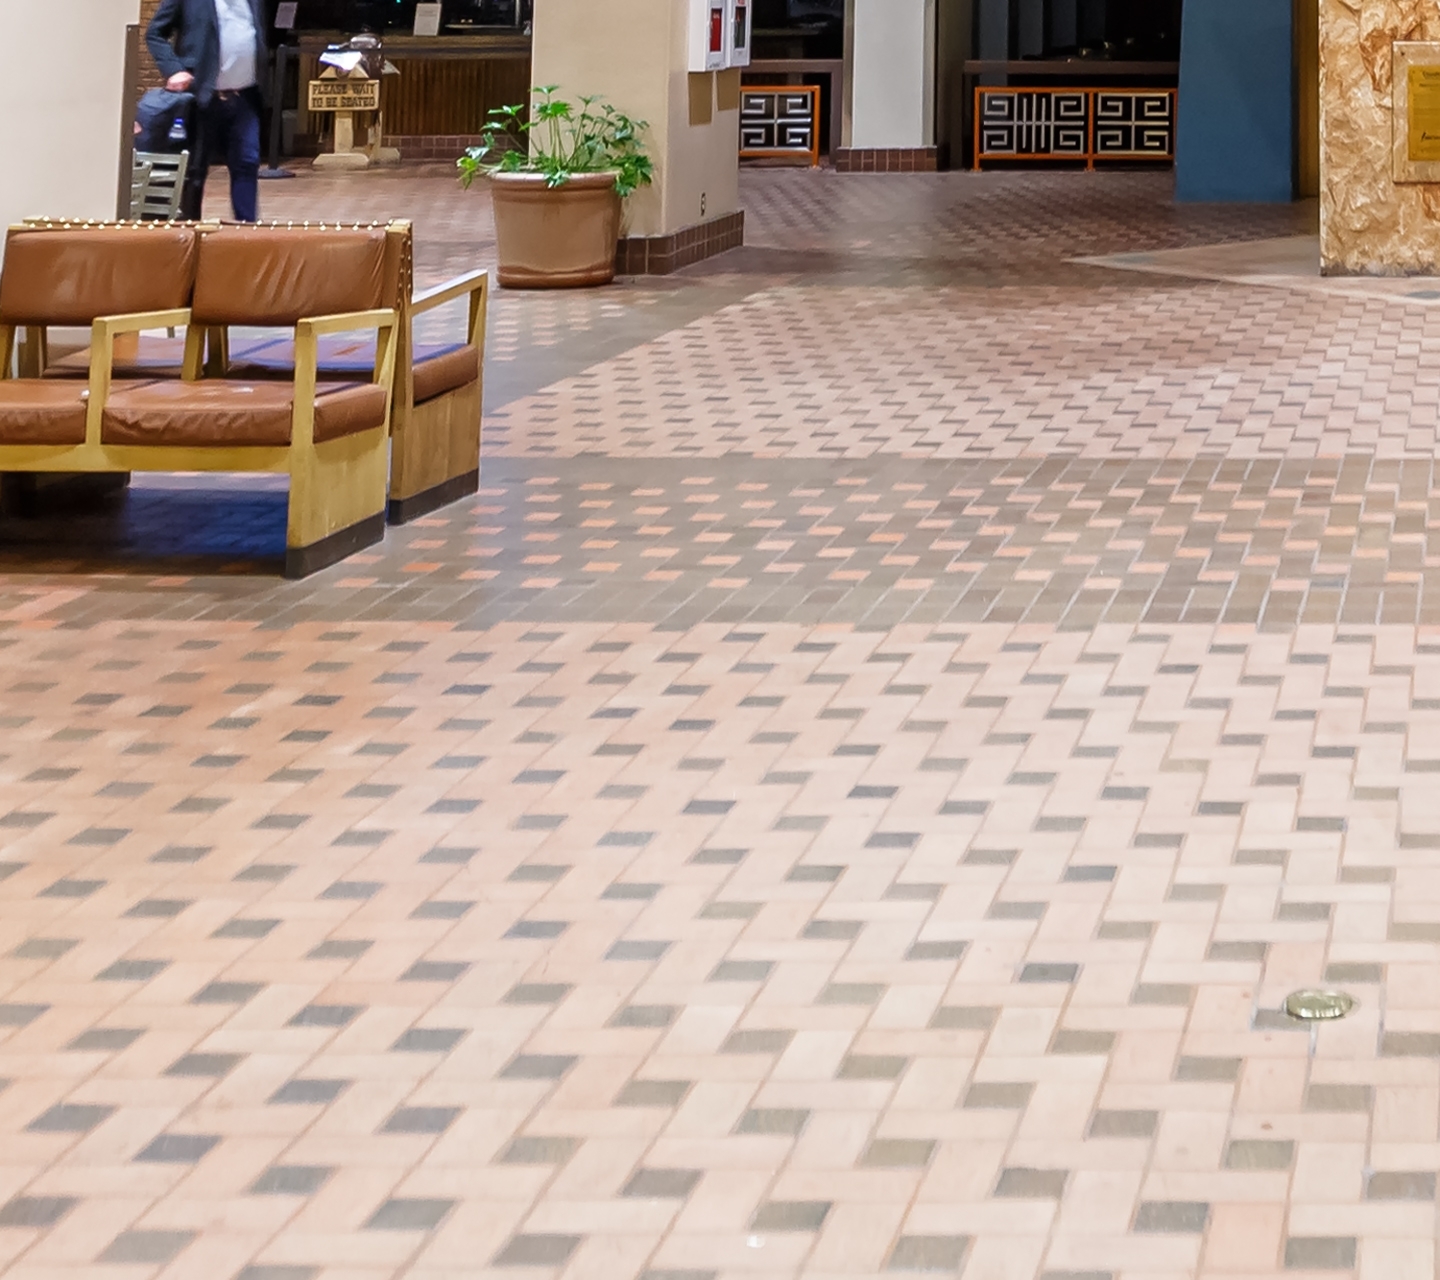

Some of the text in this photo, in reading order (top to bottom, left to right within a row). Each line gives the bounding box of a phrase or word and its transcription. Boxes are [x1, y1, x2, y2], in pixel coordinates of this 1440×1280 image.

[313, 83, 376, 95] PLEASE WAIT
[312, 96, 375, 108] TO BE SEATED
